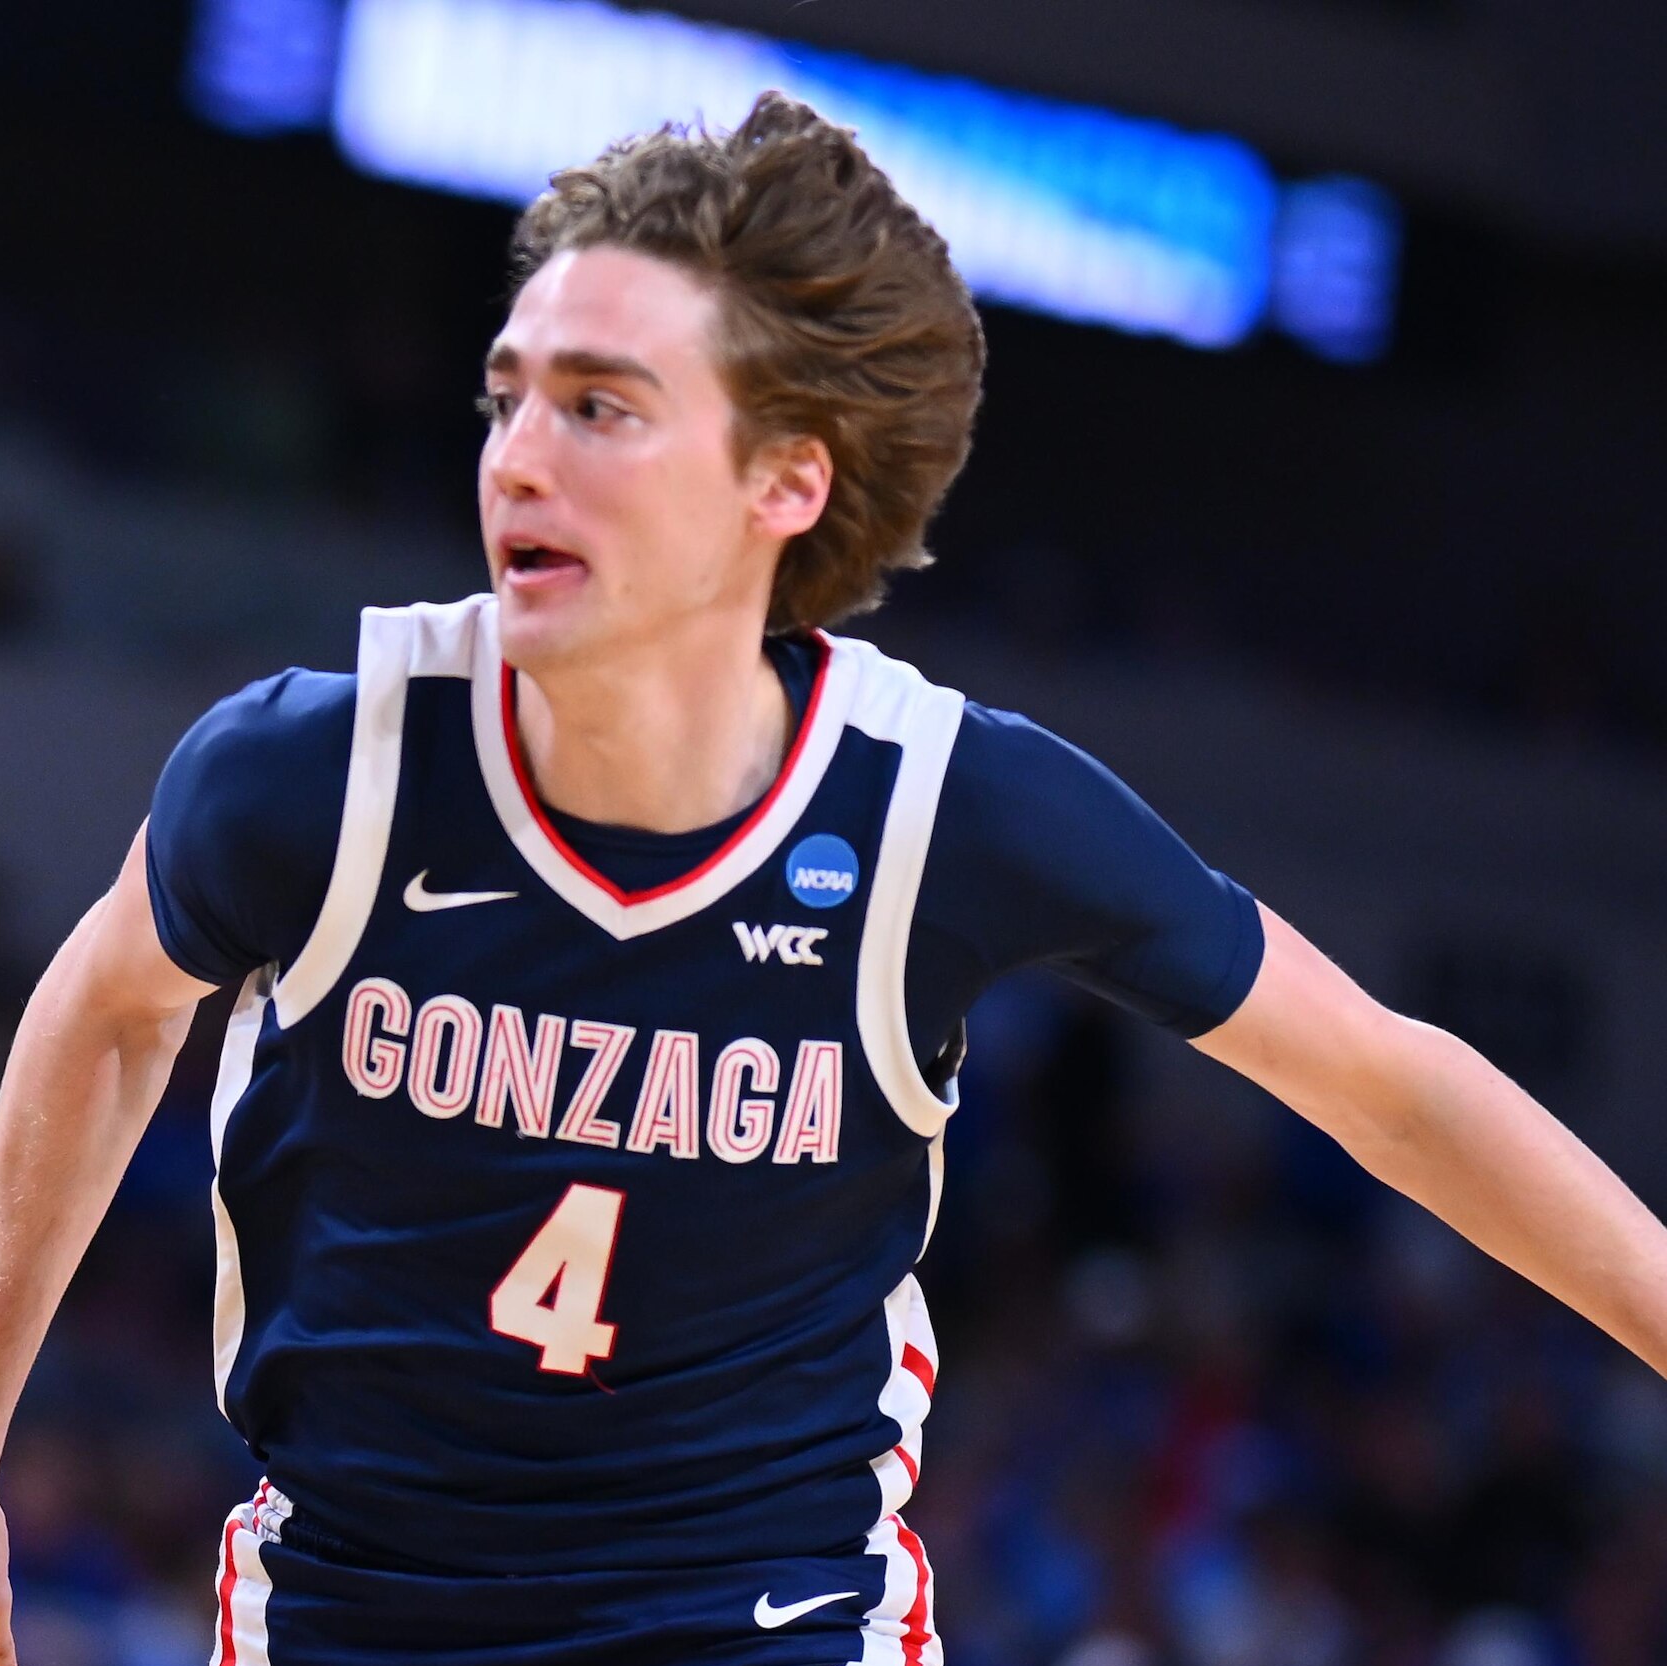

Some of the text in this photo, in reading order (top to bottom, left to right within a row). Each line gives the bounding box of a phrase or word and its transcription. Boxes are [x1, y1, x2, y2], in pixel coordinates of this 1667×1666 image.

[732, 921, 829, 966] WCC
[342, 976, 843, 1165] GONZAGA
[490, 1181, 627, 1376] 4
